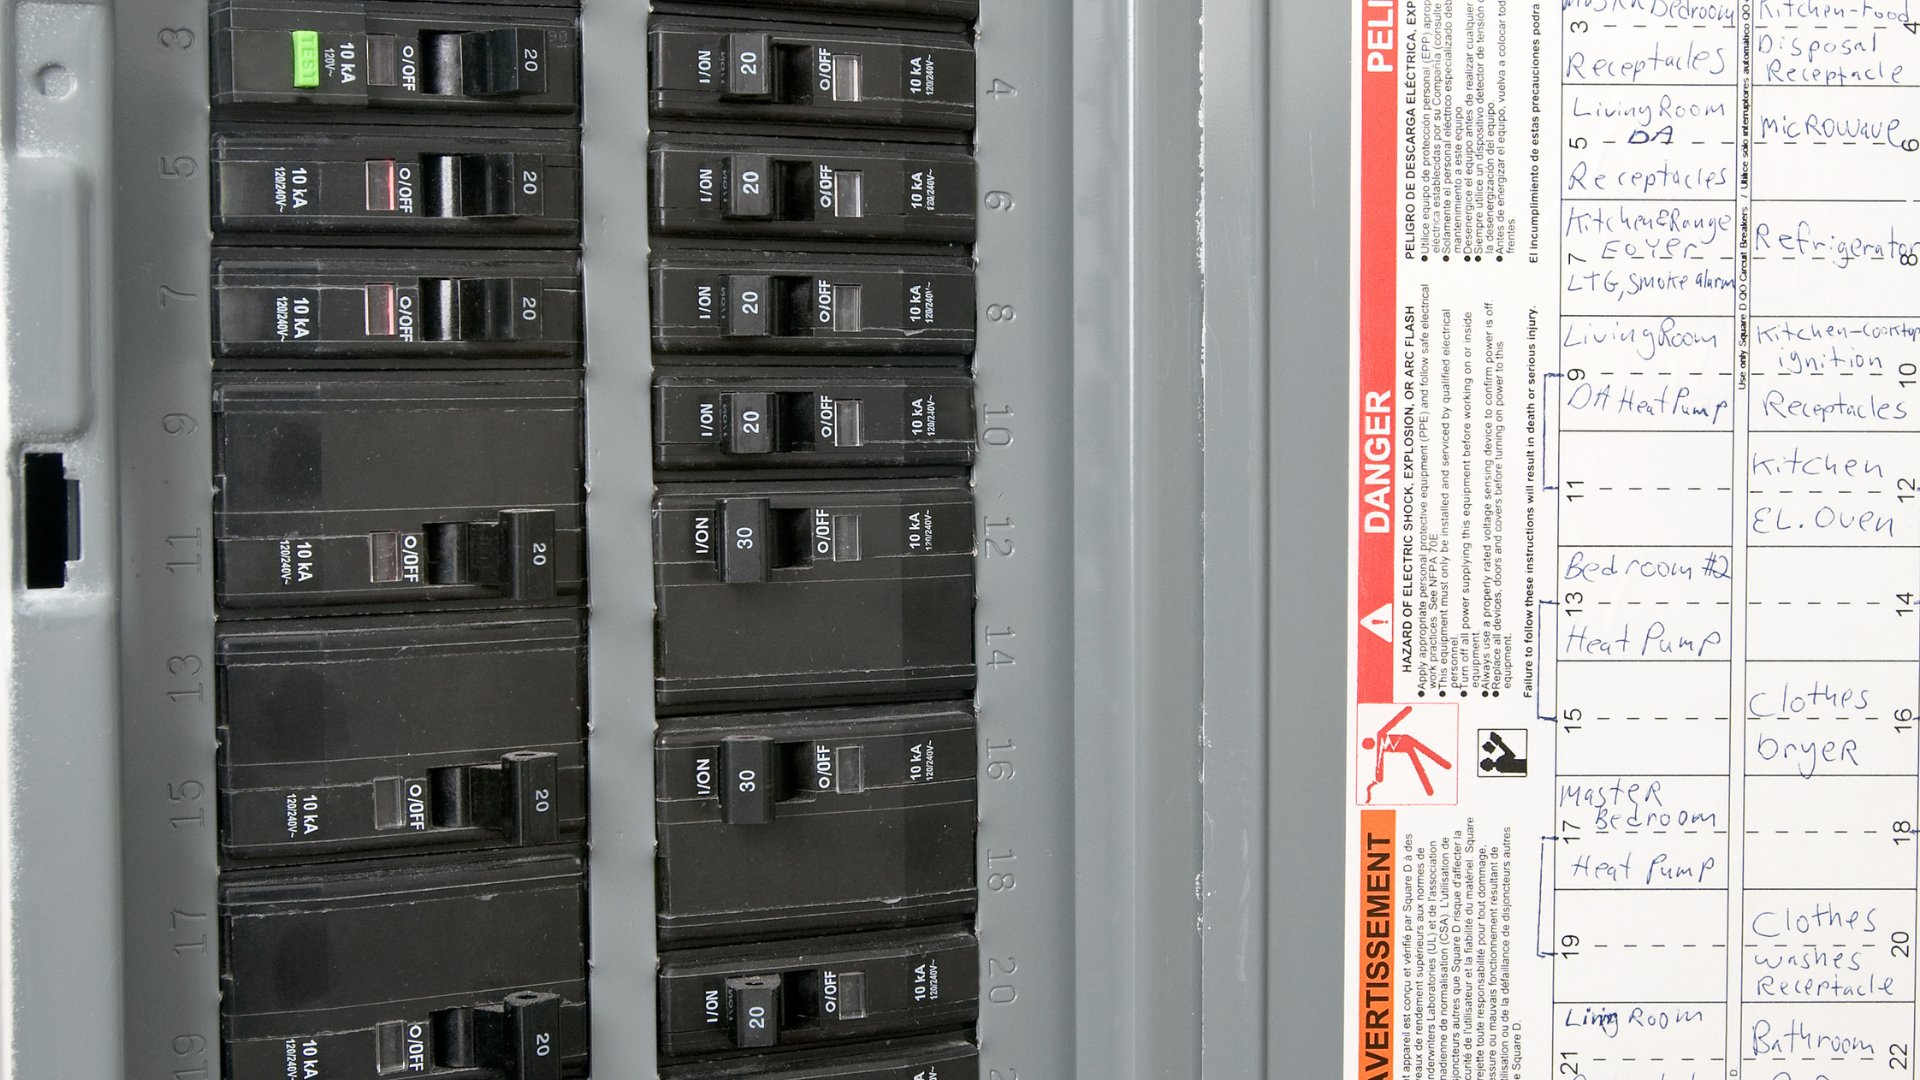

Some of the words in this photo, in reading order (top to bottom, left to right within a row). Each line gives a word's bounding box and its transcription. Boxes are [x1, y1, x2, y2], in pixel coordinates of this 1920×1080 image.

[1531, 4, 1541, 35] podrá
[1570, 21, 1588, 33] 3
[1903, 21, 1920, 34] 4
[158, 28, 195, 51] 3
[1367, 0, 1393, 72] PELI
[299, 34, 316, 84] TEST
[340, 42, 354, 60] 10
[524, 48, 538, 71] 20
[740, 52, 757, 74] 20
[909, 57, 922, 73] kA
[1566, 40, 1726, 82] Receptacles
[1758, 32, 1876, 71] Disposal
[341, 63, 356, 84] kA
[1405, 29, 1416, 104] ELÉCTRICA,
[1531, 39, 1541, 113] precauciones
[1767, 59, 1903, 86] Receptacle
[910, 77, 922, 94] 10
[986, 78, 1018, 99] 4
[1573, 96, 1651, 126] Living
[1660, 94, 1725, 117] Room
[1405, 108, 1416, 179] DESCARGA
[1531, 116, 1539, 145] estas
[1570, 137, 1588, 149] 5
[1530, 149, 1539, 161] de
[1901, 139, 1920, 152] 6
[160, 156, 198, 179] 5
[1569, 160, 1726, 193] Receptacles
[984, 190, 1016, 213] 6
[1405, 183, 1415, 200] DE
[1529, 165, 1540, 249] incumplimiento
[1405, 203, 1415, 259] PELIGRO
[1740, 207, 1748, 249] Breakers
[1529, 252, 1538, 263] El
[1568, 253, 1586, 264] 7
[1755, 221, 1920, 269] Refrigerator
[1740, 251, 1748, 280] Circuit
[1900, 254, 1918, 266] 8
[1696, 269, 1736, 291] alarm
[159, 285, 197, 309] 7
[1420, 284, 1429, 329] electrical
[986, 303, 1017, 324] 8
[1405, 306, 1414, 347] FLASH
[1527, 306, 1538, 340] injury.
[1420, 333, 1429, 354] safe
[1564, 323, 1655, 360] Living
[1659, 317, 1717, 347] Room
[1738, 314, 1747, 347] Square
[1405, 351, 1414, 377] ARC
[1420, 358, 1428, 386] follow
[1527, 344, 1536, 384] serious
[1738, 350, 1747, 366] only
[1779, 346, 1883, 374] ignition
[1567, 368, 1585, 380] 9
[1738, 368, 1746, 390] Use
[1899, 363, 1916, 387] 10
[1405, 382, 1414, 399] OR
[1420, 390, 1428, 408] and
[1528, 388, 1535, 399] or
[1618, 385, 1669, 415] Heat
[1673, 387, 1728, 425] Pump
[1526, 403, 1535, 433] death
[1763, 390, 1908, 423] Receptacles
[161, 412, 198, 435] 9
[982, 404, 1015, 448] 10
[1419, 411, 1430, 442] (PPE)
[1404, 404, 1415, 479] EXPLOSION,
[1526, 437, 1534, 447] in
[1365, 390, 1391, 533] DANGER
[1420, 445, 1429, 498] equipment
[1526, 451, 1534, 481] result
[1752, 448, 1884, 478] Kitchen
[1526, 486, 1534, 503] will
[1567, 481, 1584, 502] 11
[1897, 478, 1916, 503] 12
[1404, 483, 1414, 531] SHOCK,
[1815, 506, 1893, 537] Oven
[737, 527, 753, 550] 30
[983, 517, 1016, 559] 12
[1419, 501, 1429, 551] protective
[1525, 507, 1534, 573] instructions
[166, 528, 201, 574] 11
[532, 542, 546, 566] 20
[1403, 535, 1413, 597] ELECTRIC
[1419, 554, 1428, 597] personal
[1564, 551, 1692, 582] Bedroom
[1702, 552, 1732, 579] #2
[1525, 577, 1533, 606] these
[1566, 592, 1583, 617] 13
[1896, 592, 1914, 617] 14
[1403, 601, 1412, 617] OF
[1419, 601, 1428, 658] appropriate
[1524, 610, 1533, 643] follow
[1566, 624, 1630, 655] Heat
[1642, 622, 1721, 656] Pump
[984, 626, 1017, 671] 14
[1403, 621, 1412, 672] HAZARD
[1525, 647, 1533, 657] to
[167, 655, 203, 704] 13
[1418, 662, 1428, 690] Apply
[1524, 661, 1533, 698] Failure
[1749, 681, 1868, 717] Clothes
[1564, 709, 1582, 734] 15
[1894, 709, 1913, 734] 16
[985, 738, 1017, 782] 16
[739, 770, 756, 792] 30
[167, 780, 204, 829] 15
[1595, 805, 1716, 830] Bedroom
[1563, 821, 1581, 844] 17
[1893, 821, 1911, 845] 18
[986, 849, 1018, 893] 18
[1571, 851, 1631, 881] Heat
[1646, 853, 1715, 885] Pump
[1404, 875, 1414, 912] Square
[172, 908, 207, 956] 17
[1405, 915, 1414, 931] par
[1752, 903, 1876, 937] Clothes
[1403, 935, 1411, 965] vérifié
[1562, 935, 1579, 958] 19
[1891, 932, 1909, 958] 20
[988, 956, 1019, 1005] 20
[1404, 968, 1411, 977] et
[1757, 973, 1894, 997] Receptacle
[1404, 980, 1414, 1011] conçu
[749, 1007, 765, 1029] 20
[1403, 1014, 1411, 1029] est
[1629, 1007, 1702, 1029] Room
[1402, 1032, 1413, 1072] appareil
[1752, 1019, 1875, 1056] Bathroom
[172, 1034, 208, 1080] 19
[1560, 1052, 1578, 1075] 21
[1889, 1044, 1908, 1069] 22
